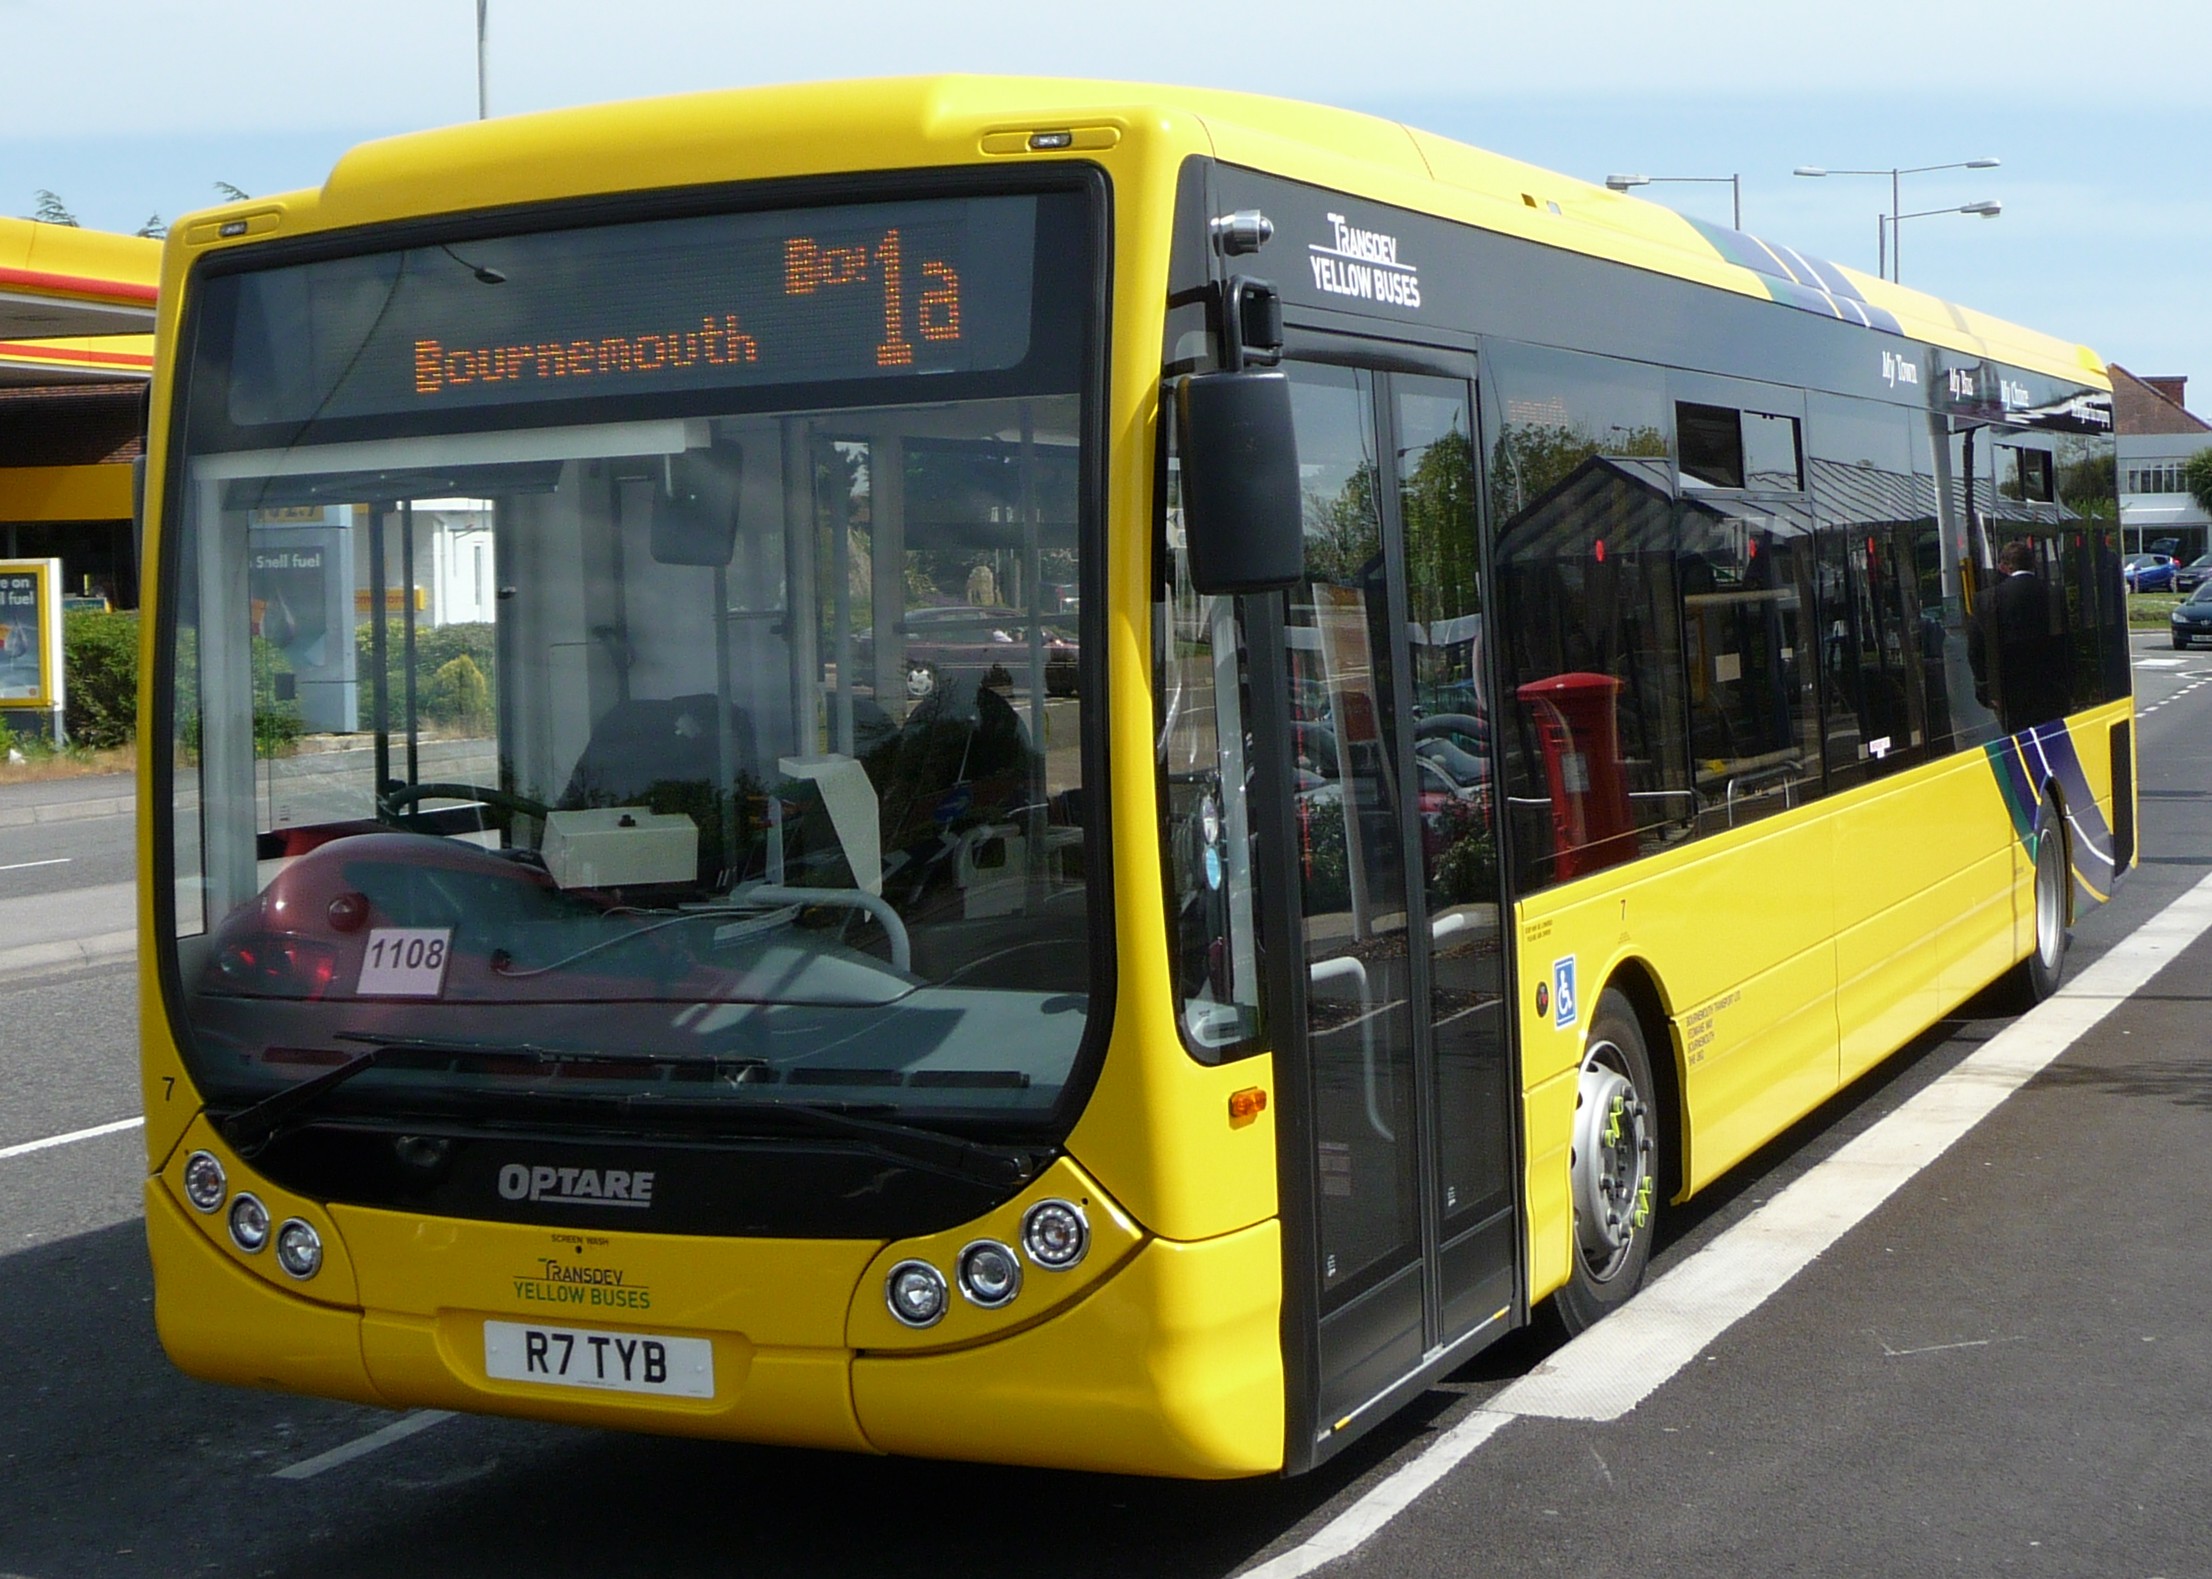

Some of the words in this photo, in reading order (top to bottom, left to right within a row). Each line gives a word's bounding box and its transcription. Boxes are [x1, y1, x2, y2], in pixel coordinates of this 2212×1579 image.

[1310, 255, 1372, 299] YELLOW
[1373, 269, 1421, 308] BUSES
[415, 314, 757, 393] Bournemouth
[1882, 350, 1895, 388] My
[1949, 367, 1960, 401] My
[292, 553, 321, 568] fuel
[8, 591, 34, 605] fuel
[11, 578, 30, 588] on
[1620, 899, 1626, 921] 7
[371, 938, 445, 969] 1108
[162, 1076, 175, 1102] 7
[498, 1163, 655, 1208] OPTARE
[514, 1281, 585, 1304] YELLOW
[591, 1288, 650, 1309] BUSES
[525, 1330, 575, 1375] R7
[587, 1336, 667, 1384] TYB
